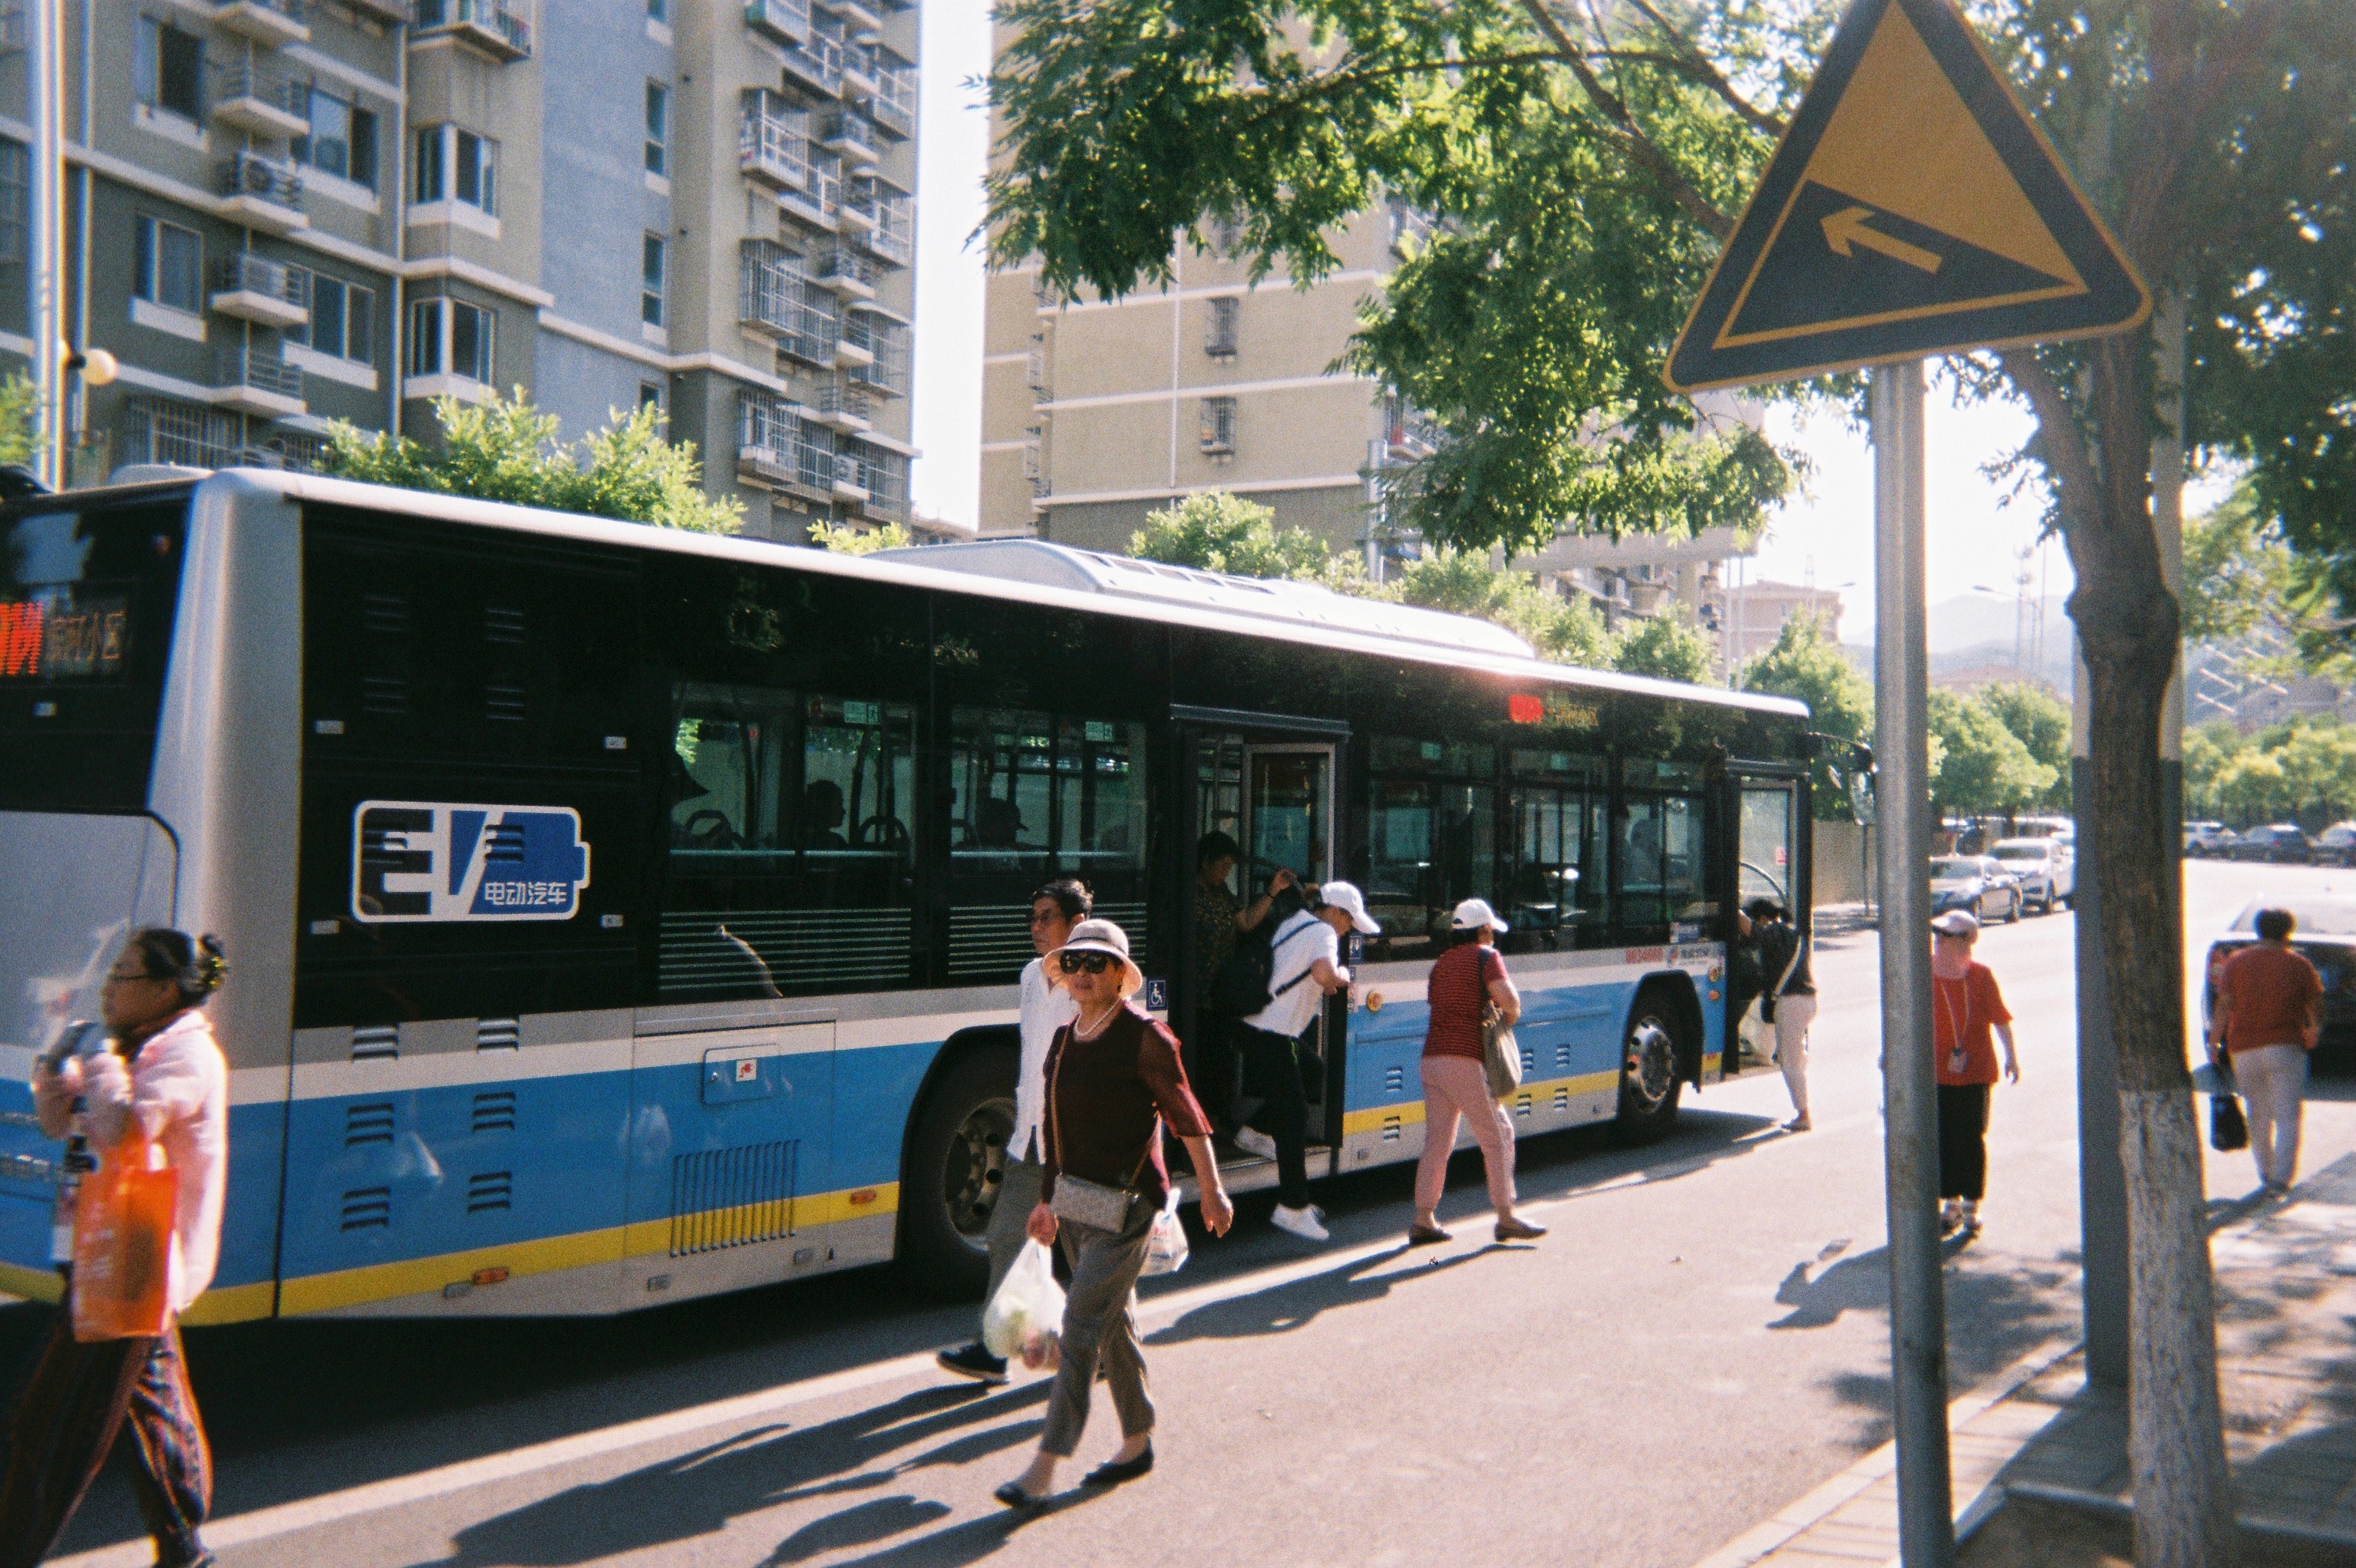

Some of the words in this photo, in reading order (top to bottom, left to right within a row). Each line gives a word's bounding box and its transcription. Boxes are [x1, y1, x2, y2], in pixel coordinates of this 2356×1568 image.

[358, 804, 504, 918] EV
[484, 882, 567, 906] 电动汽车
